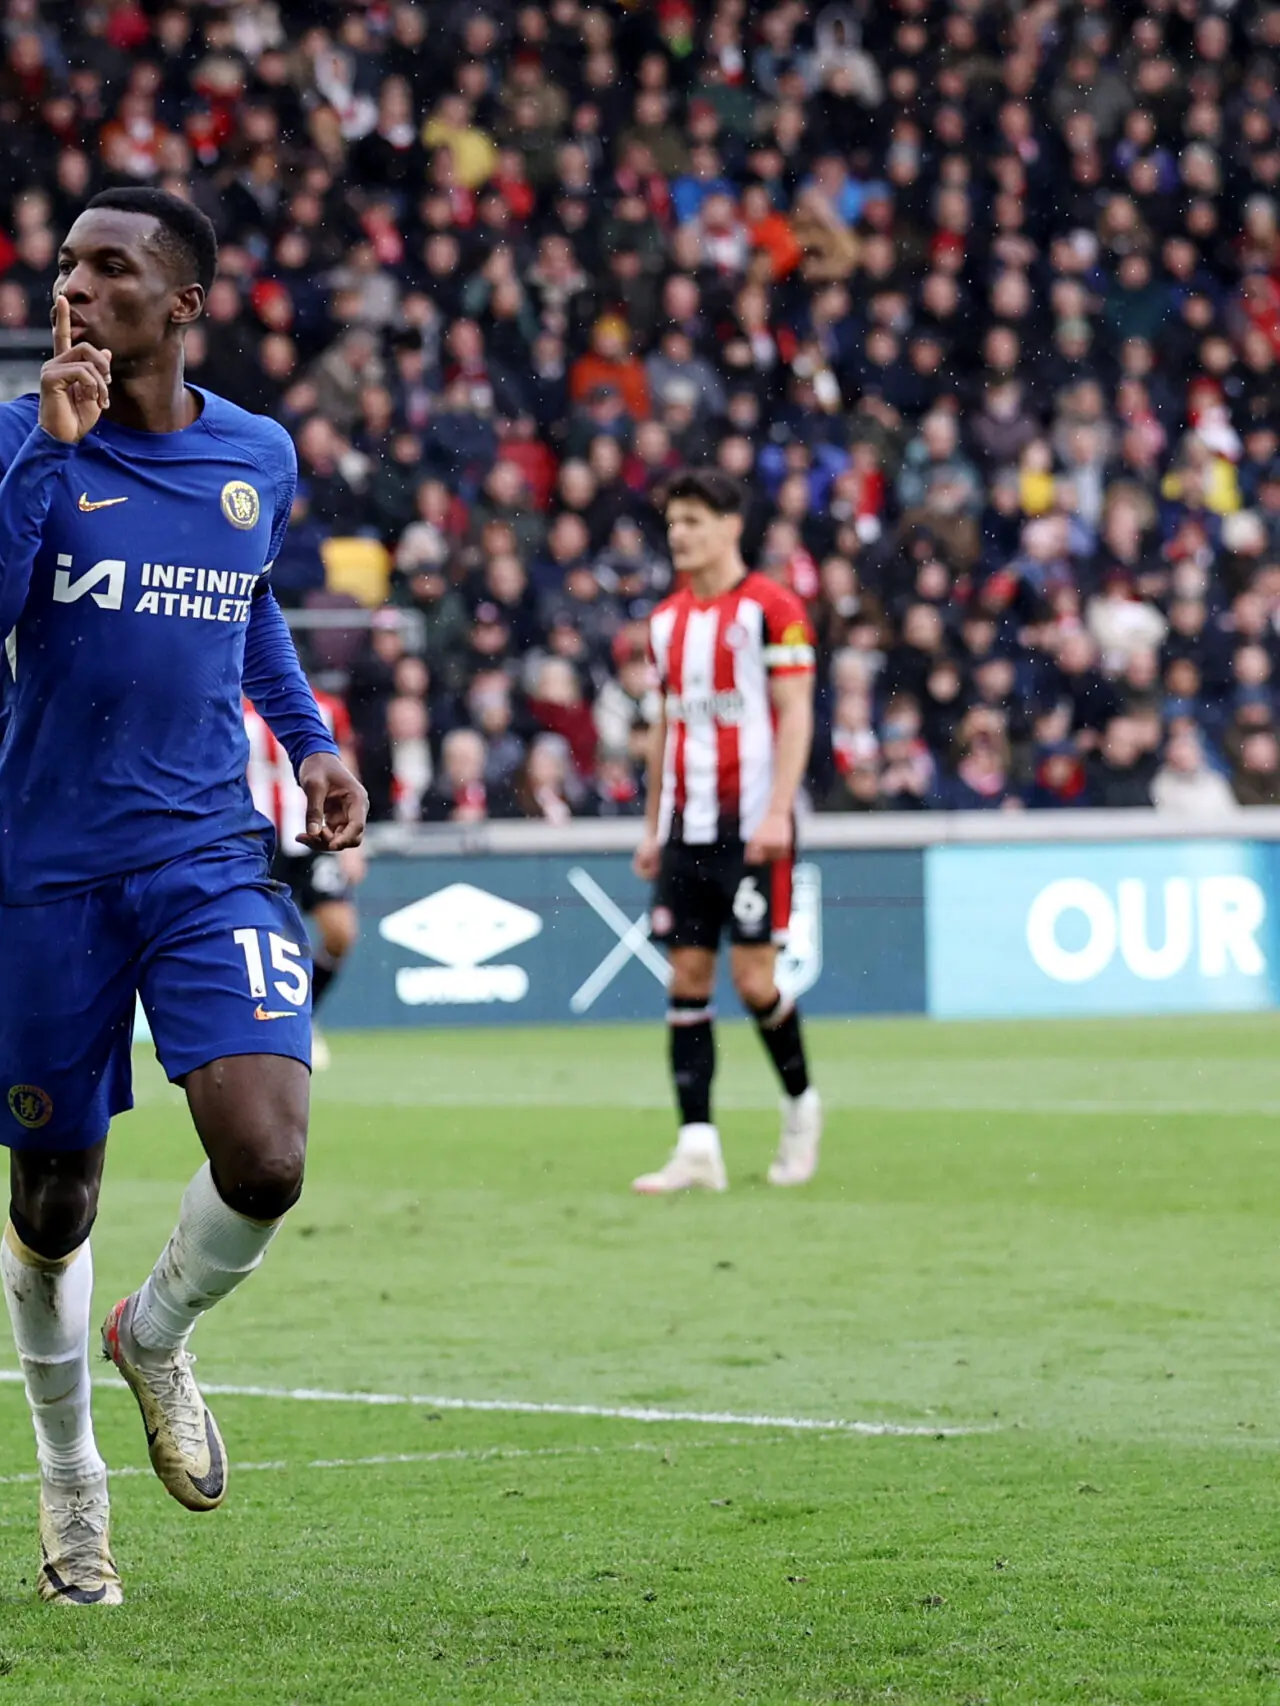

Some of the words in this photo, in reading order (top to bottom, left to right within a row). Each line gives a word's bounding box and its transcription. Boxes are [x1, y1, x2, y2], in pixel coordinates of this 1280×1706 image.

[134, 591, 253, 622] ATHLETE
[733, 876, 768, 922] 6
[1026, 876, 1266, 983] OUR
[233, 928, 308, 1006] 15
